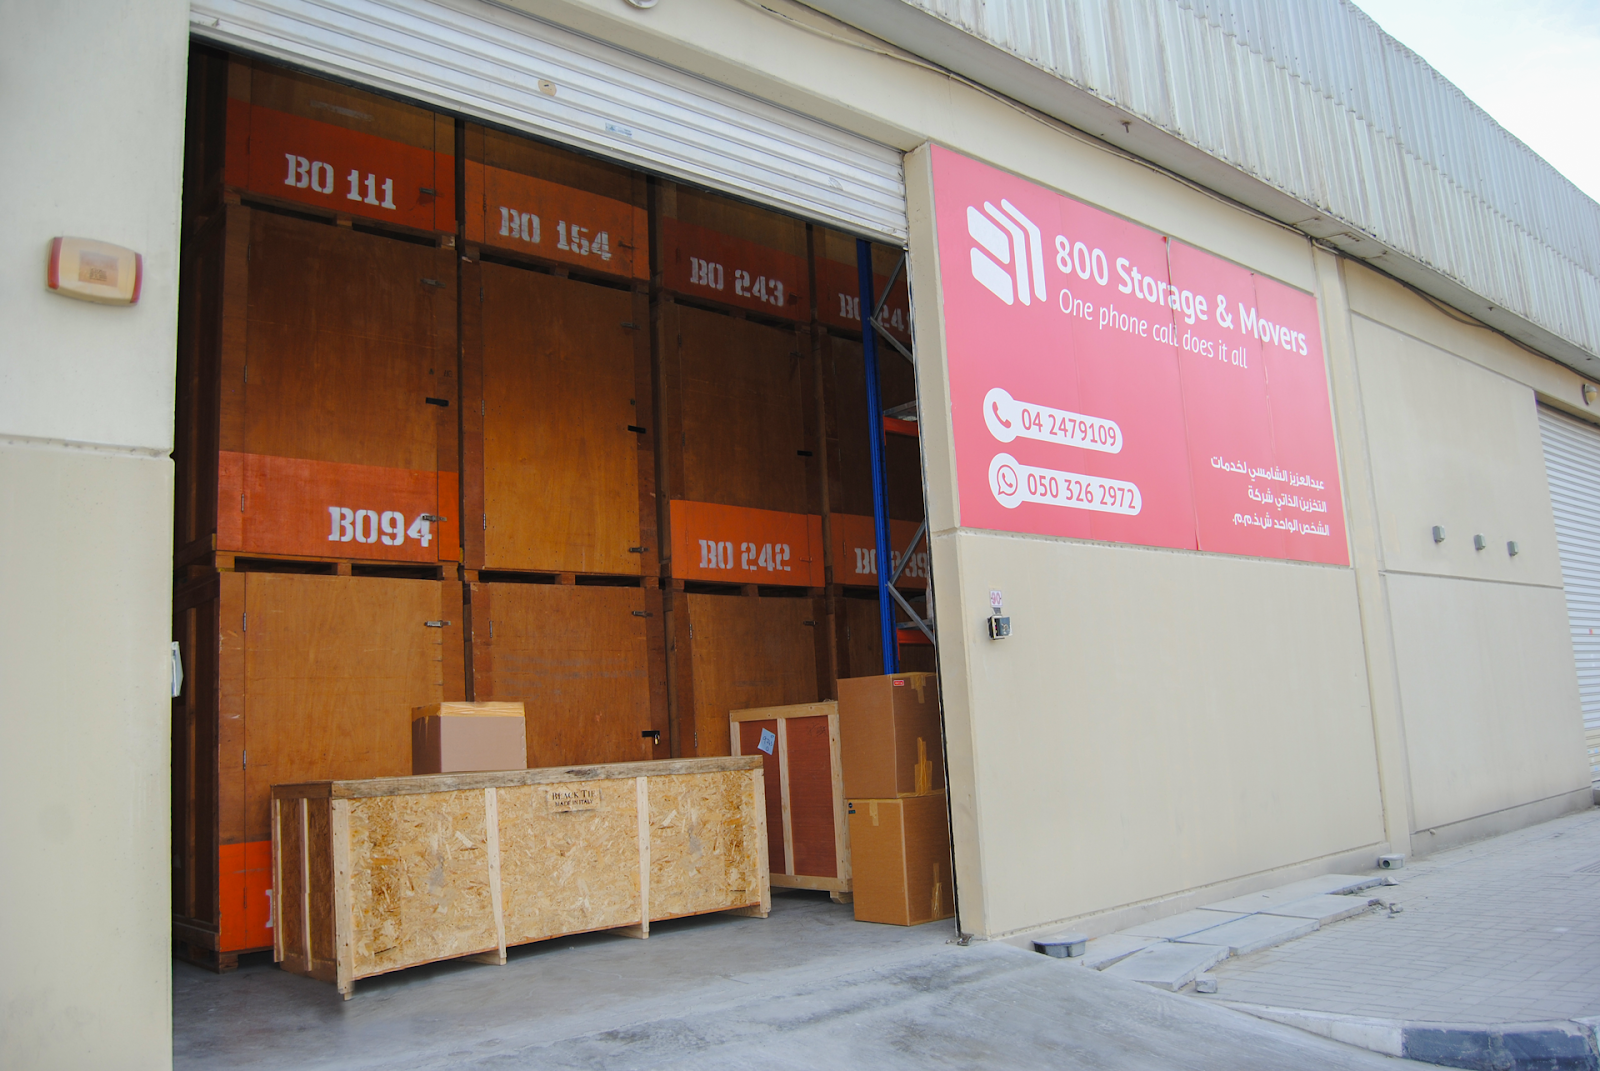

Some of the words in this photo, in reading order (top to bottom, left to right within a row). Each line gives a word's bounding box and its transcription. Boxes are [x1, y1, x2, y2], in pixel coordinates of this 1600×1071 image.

[346, 169, 397, 210] 111
[556, 220, 612, 261] 154
[734, 269, 784, 307] 243
[1055, 235, 1109, 286] 800
[1116, 257, 1208, 324] Storage
[1216, 294, 1234, 330] &
[1238, 302, 1308, 356] Movers
[1059, 289, 1093, 321] One
[1100, 304, 1148, 337] phone
[1153, 323, 1179, 347] call
[1182, 330, 1214, 358] does
[1218, 340, 1228, 362] it
[1231, 348, 1248, 369] all
[1021, 408, 1043, 433] 04
[1048, 413, 1117, 447] 2479109
[1210, 456, 1248, 474] لخدمات
[1248, 466, 1288, 482] الشامسي
[1027, 473, 1059, 499] 050
[1064, 478, 1094, 504] 326
[1099, 484, 1136, 510] 2972
[1248, 485, 1274, 504] شركة
[1274, 493, 1299, 511] الذاتي
[1299, 497, 1327, 513] التخزين
[1274, 518, 1299, 533] الواحد
[1299, 520, 1330, 536] الشخص
[741, 541, 791, 571] 242
